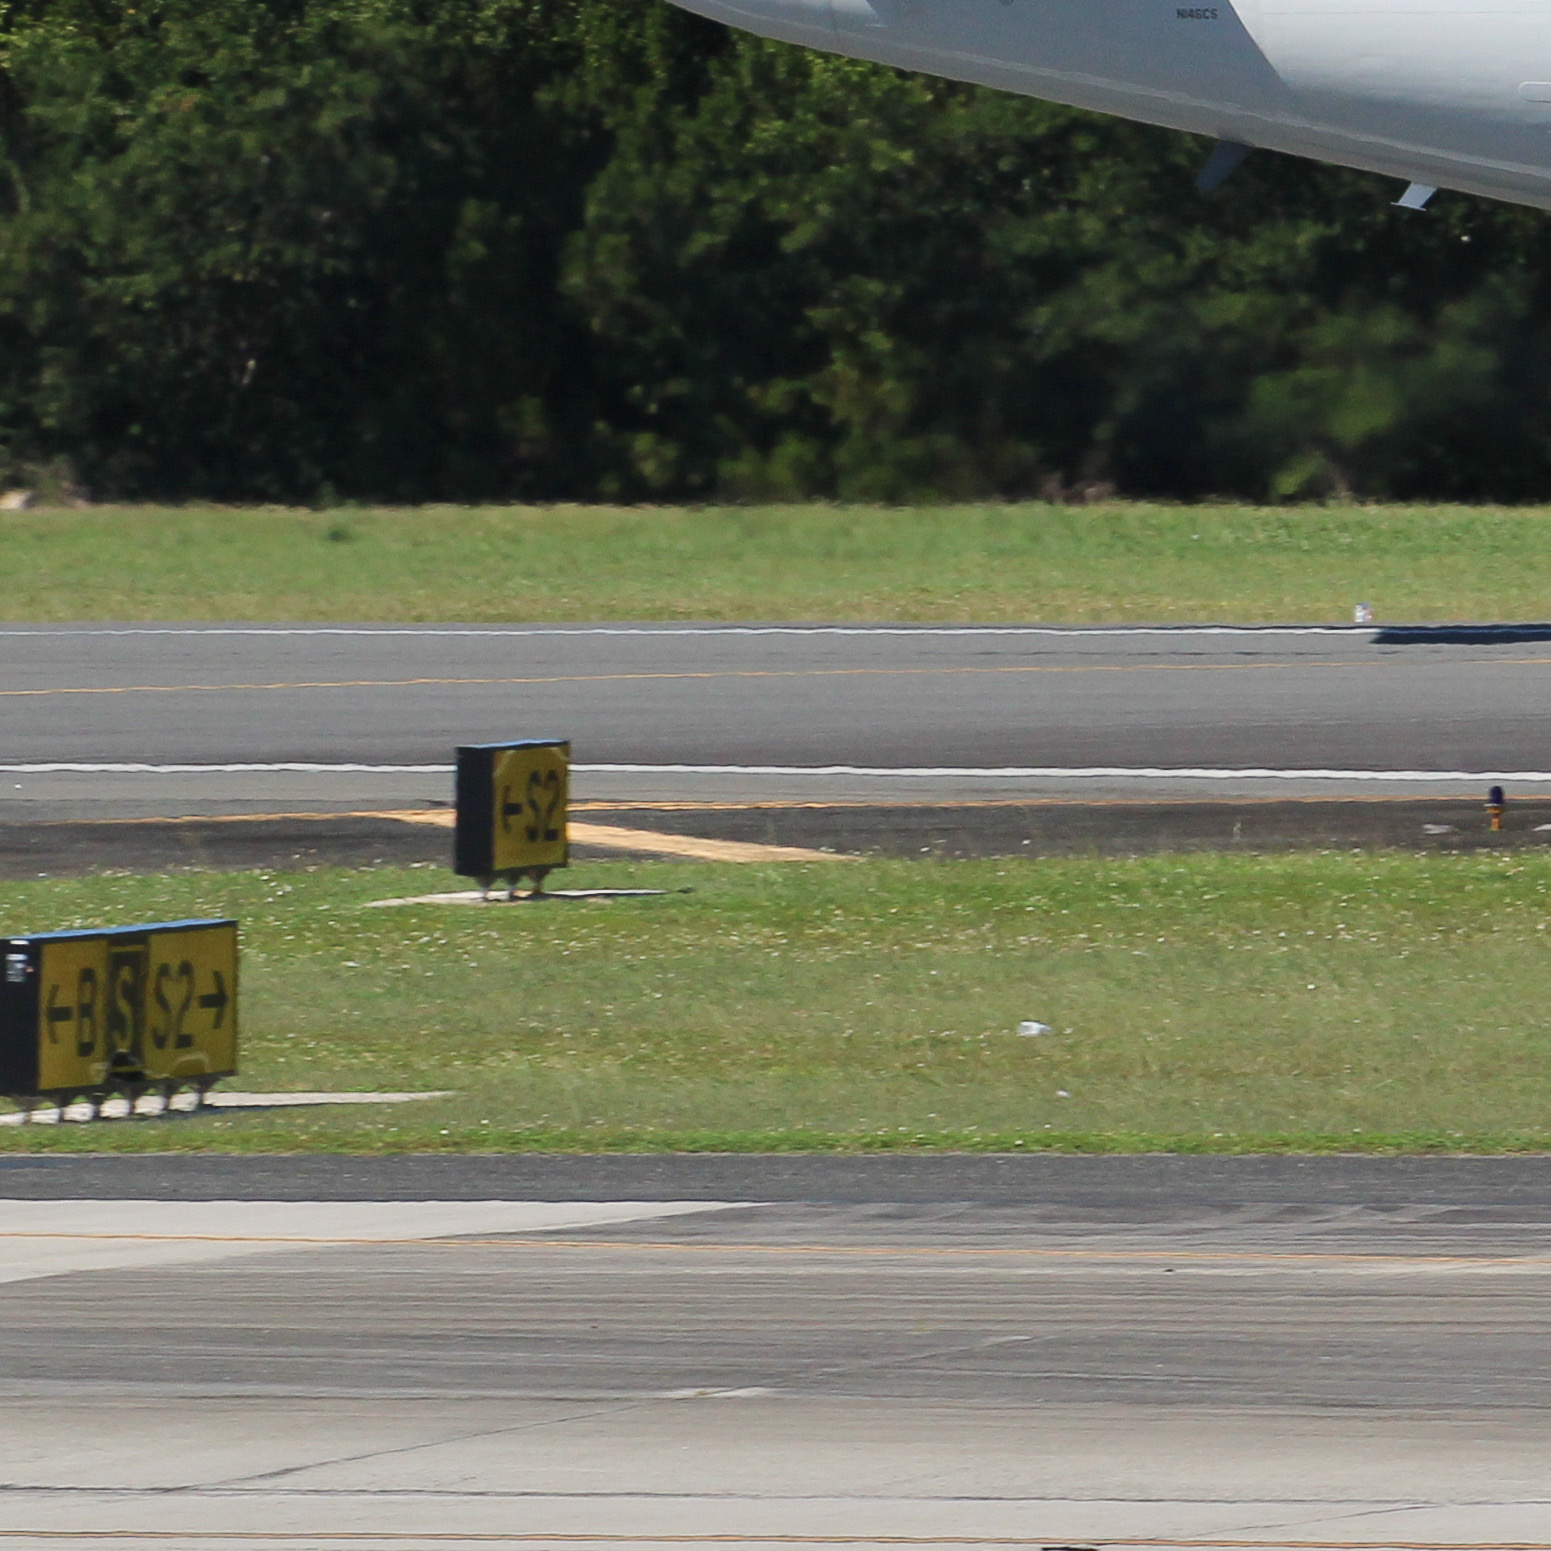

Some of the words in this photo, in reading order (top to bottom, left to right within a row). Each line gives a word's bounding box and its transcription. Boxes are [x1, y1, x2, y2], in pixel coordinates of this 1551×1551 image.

[526, 768, 561, 843] S2
[78, 967, 96, 1058] B
[154, 959, 196, 1050] S2
